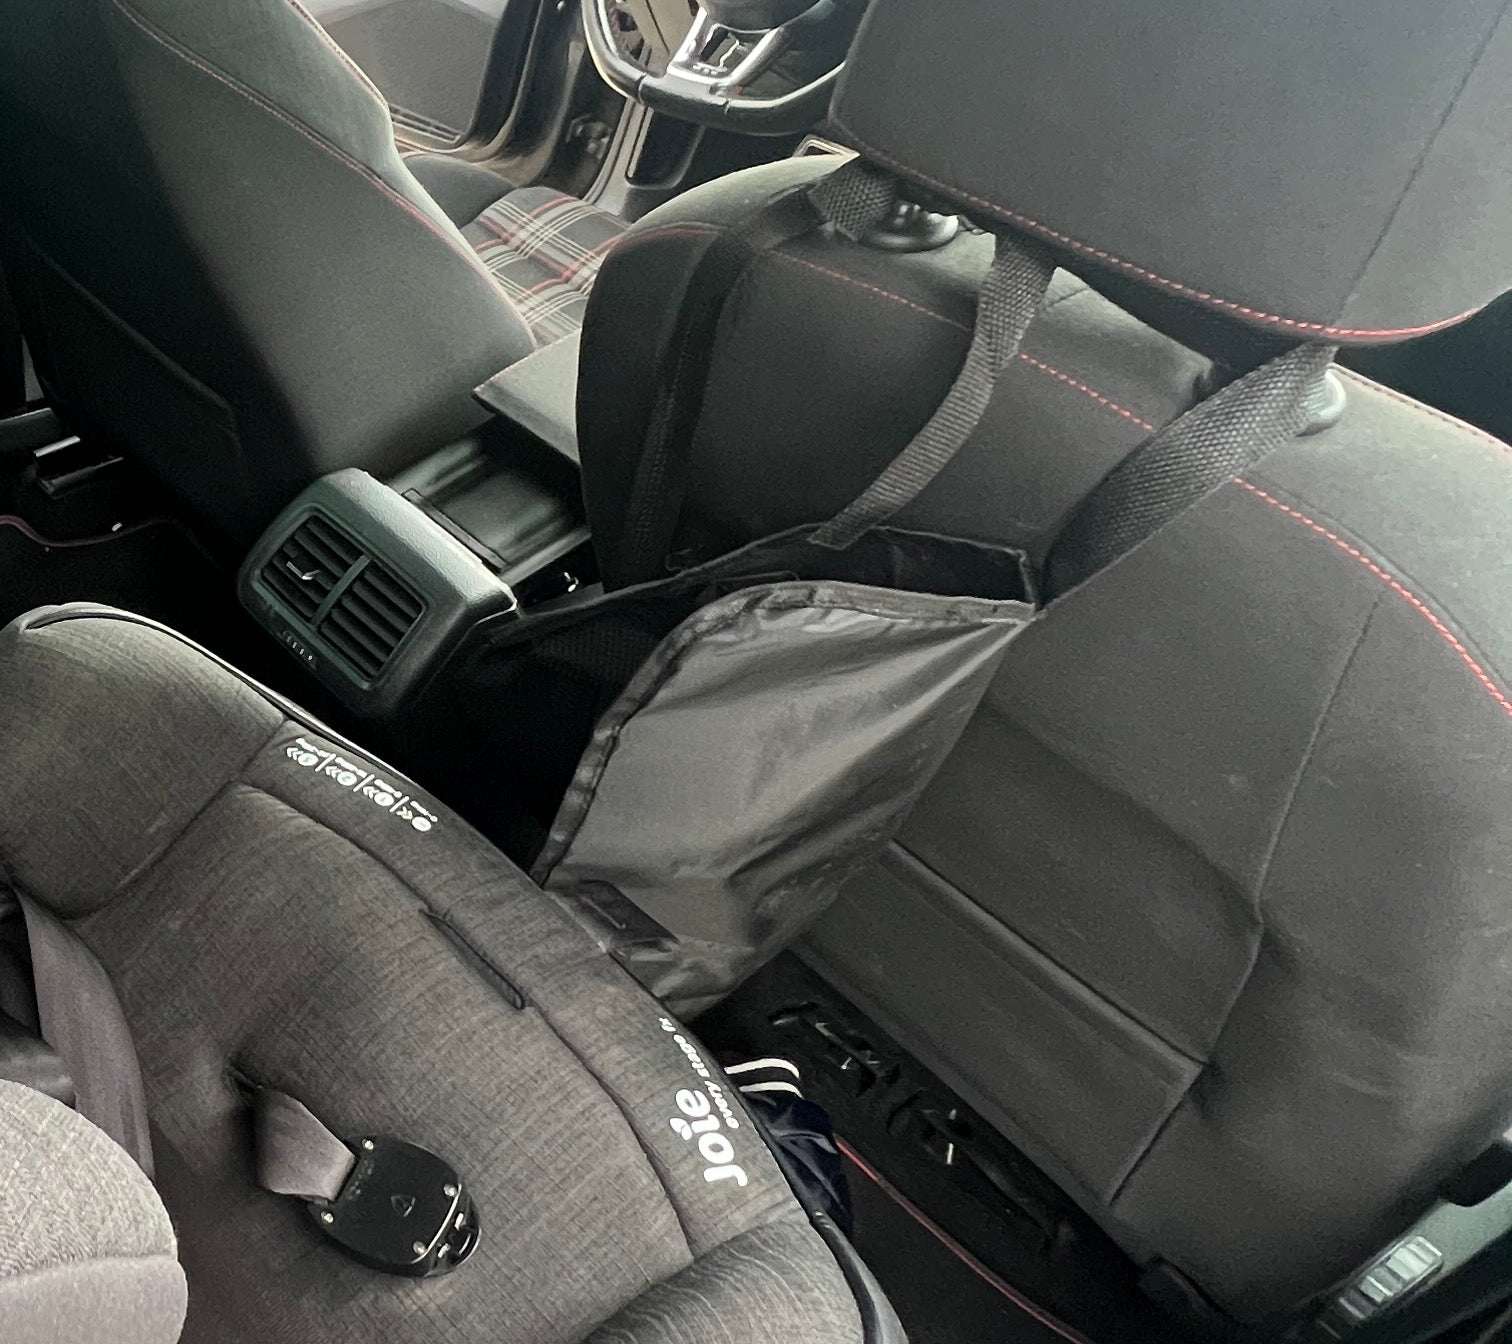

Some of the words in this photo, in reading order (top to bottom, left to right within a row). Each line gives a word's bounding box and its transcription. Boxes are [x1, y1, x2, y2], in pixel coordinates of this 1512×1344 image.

[674, 1034, 711, 1076] stage
[703, 1080, 740, 1129] every
[670, 1088, 748, 1187] Joie
